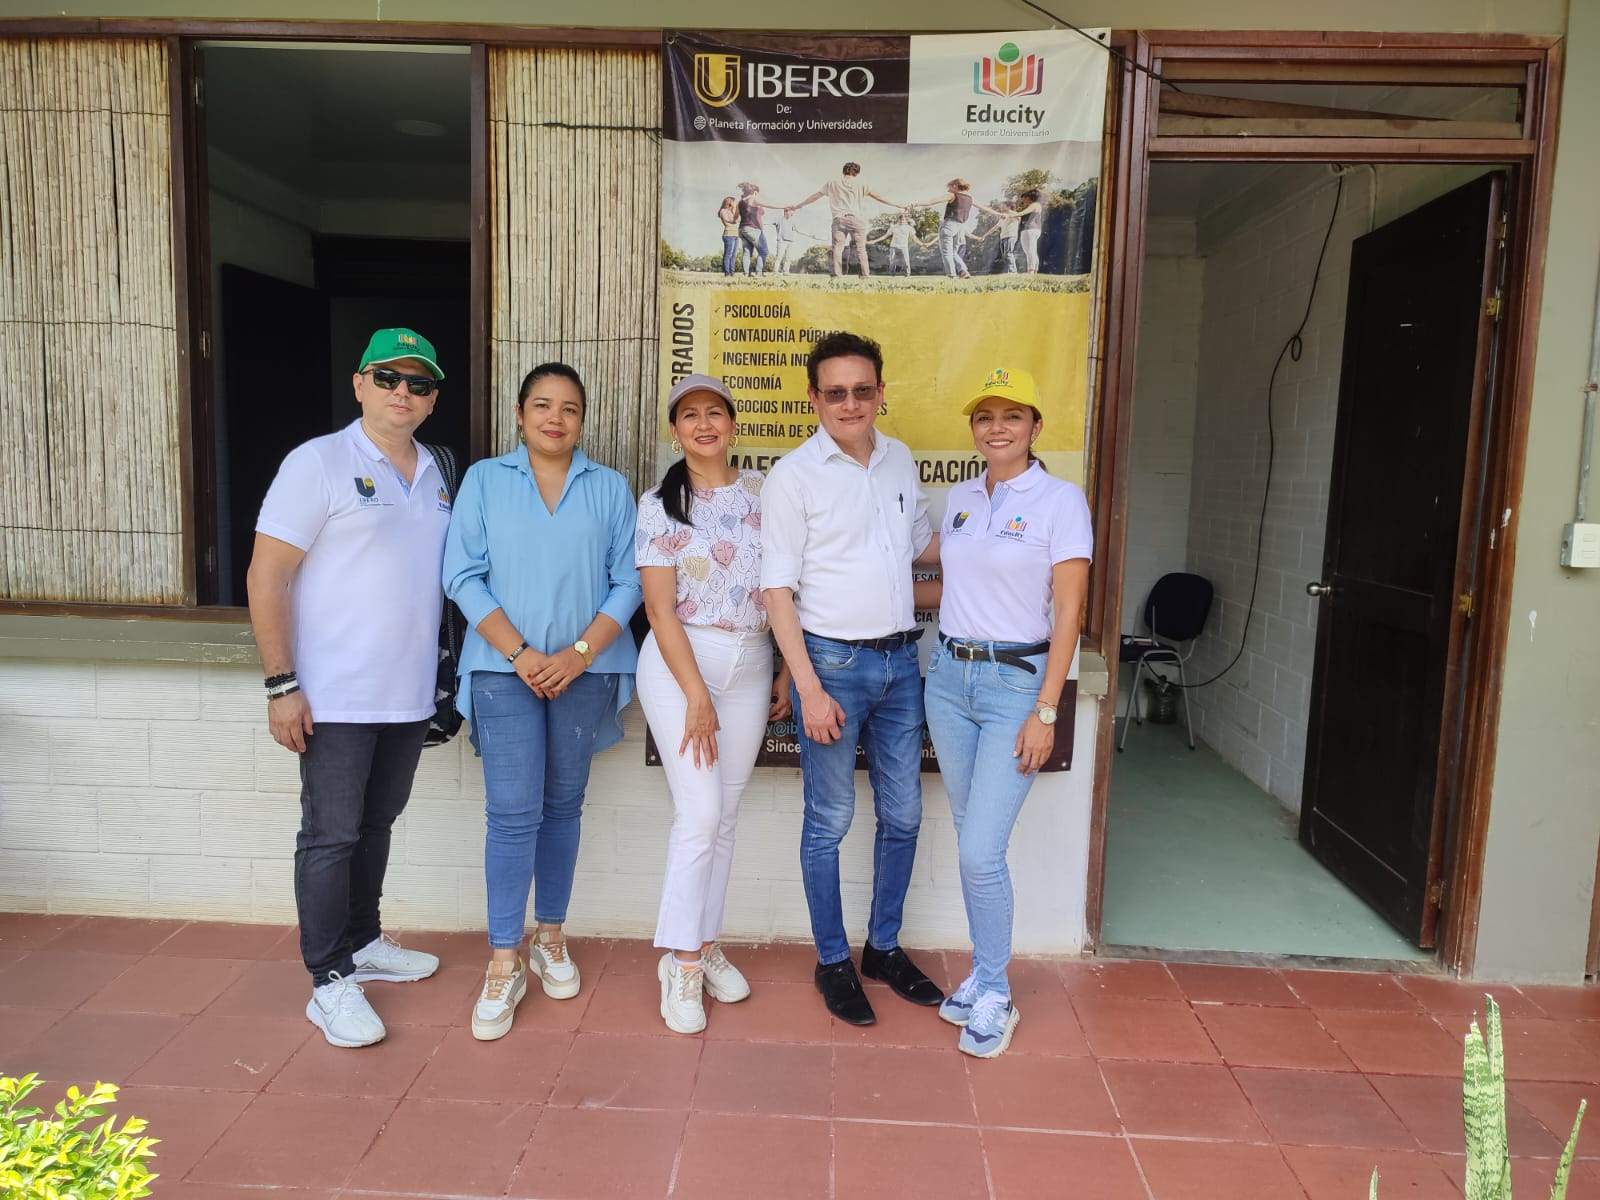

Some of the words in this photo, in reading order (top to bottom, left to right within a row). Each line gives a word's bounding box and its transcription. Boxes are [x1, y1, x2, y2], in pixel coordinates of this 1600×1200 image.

[747, 62, 875, 98] IBERO
[776, 104, 792, 114] De:
[966, 104, 1046, 129] Educity
[709, 118, 744, 130] Planeta
[746, 118, 796, 130] Formación
[797, 121, 804, 132] y
[806, 119, 873, 131] Universidades
[961, 129, 997, 138] Operador
[1000, 128, 1050, 137] Universitario
[724, 302, 791, 319] PSICOLOGÍA
[723, 326, 795, 343] CONTADURÍA
[722, 350, 788, 367] INGENIERÍA
[789, 424, 804, 438] DE
